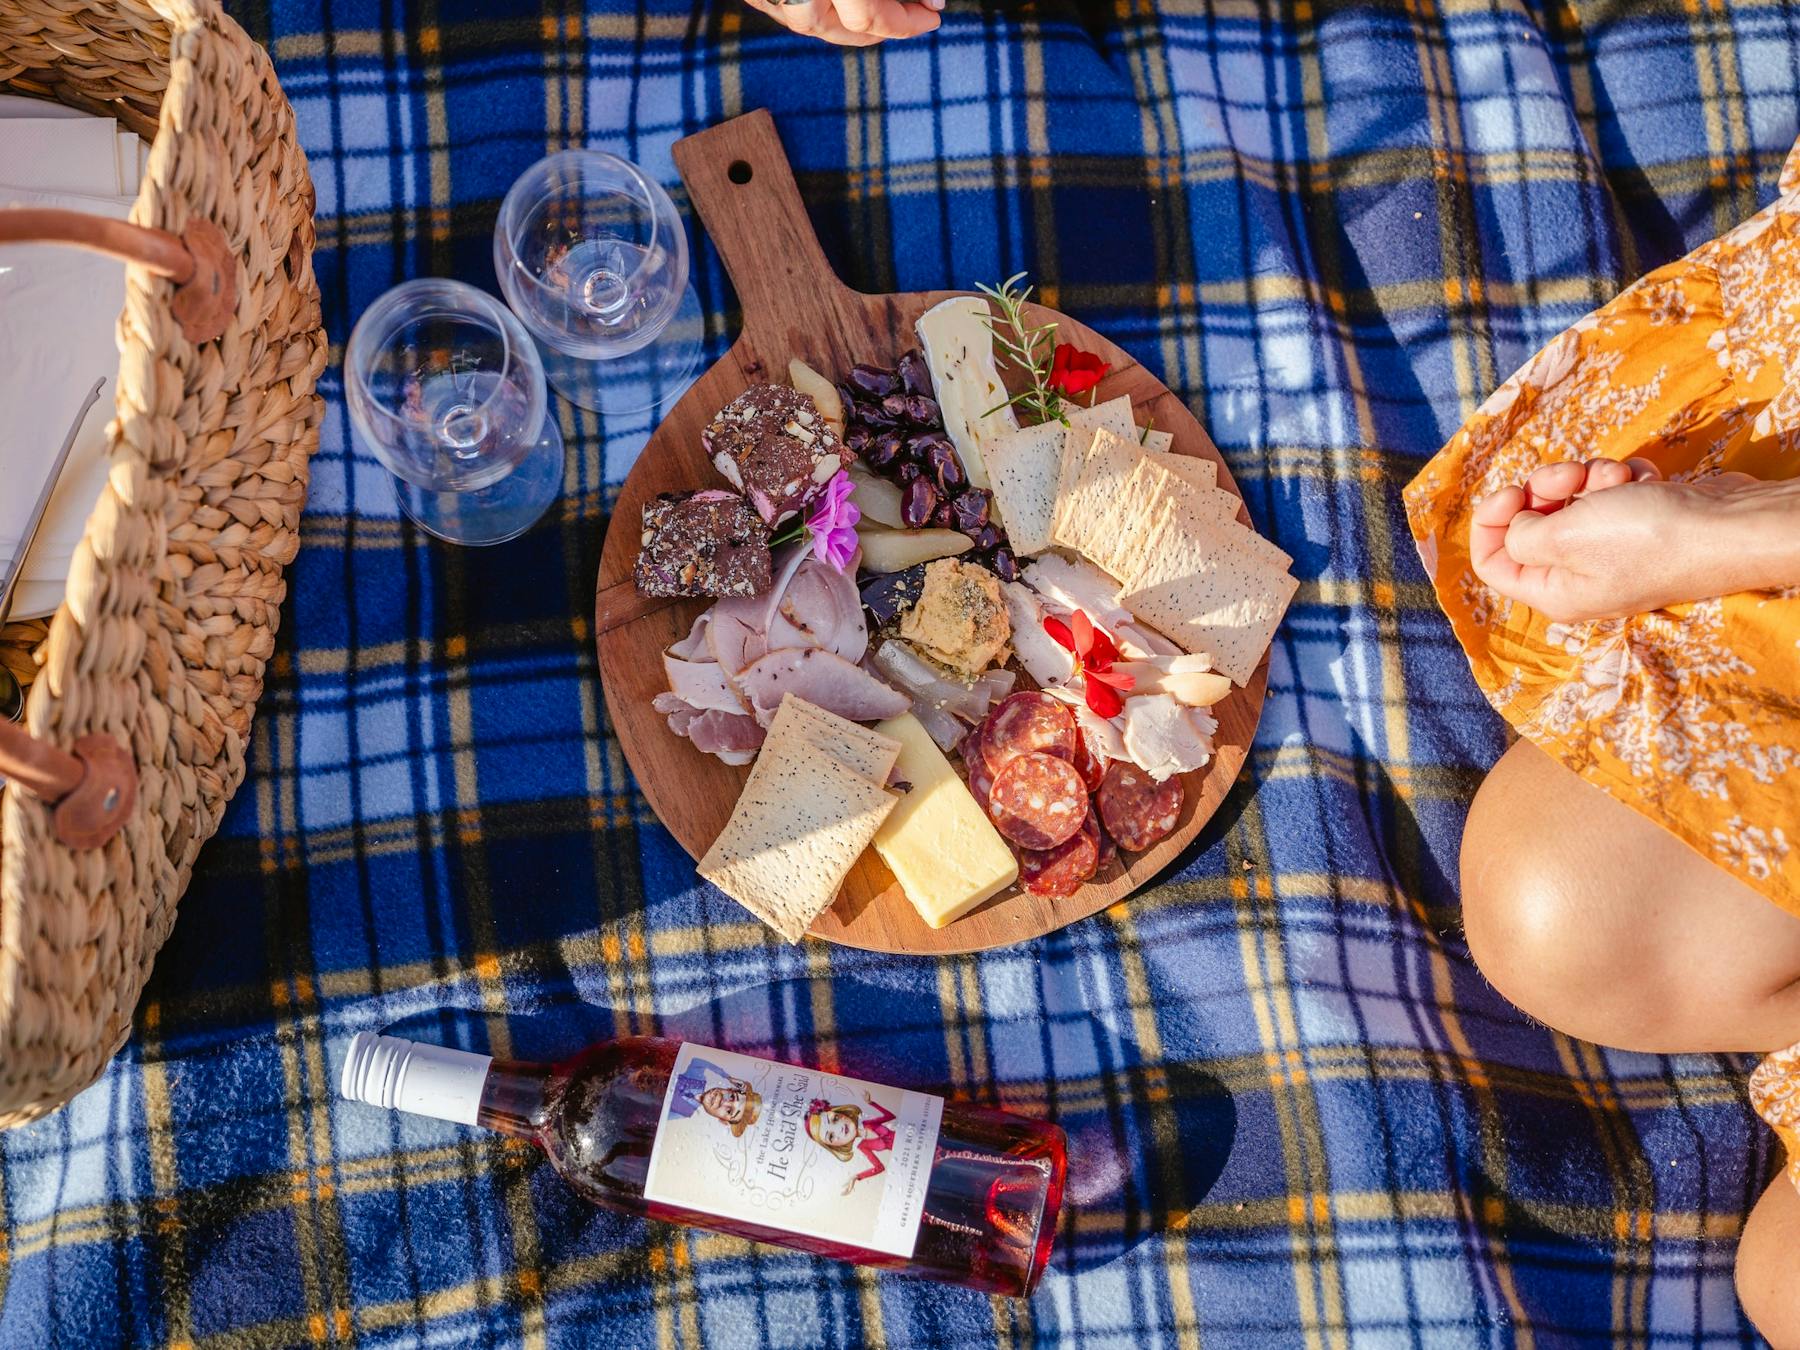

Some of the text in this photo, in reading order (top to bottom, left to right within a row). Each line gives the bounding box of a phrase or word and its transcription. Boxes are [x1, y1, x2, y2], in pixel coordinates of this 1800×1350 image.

[786, 1073, 810, 1093] Said
[781, 1095, 804, 1117] She
[757, 1100, 778, 1164] the Lake House
[772, 1119, 797, 1152] Said
[767, 1156, 789, 1180] He
[900, 1147, 910, 1167] 2021
[900, 1202, 911, 1228] GREAT
